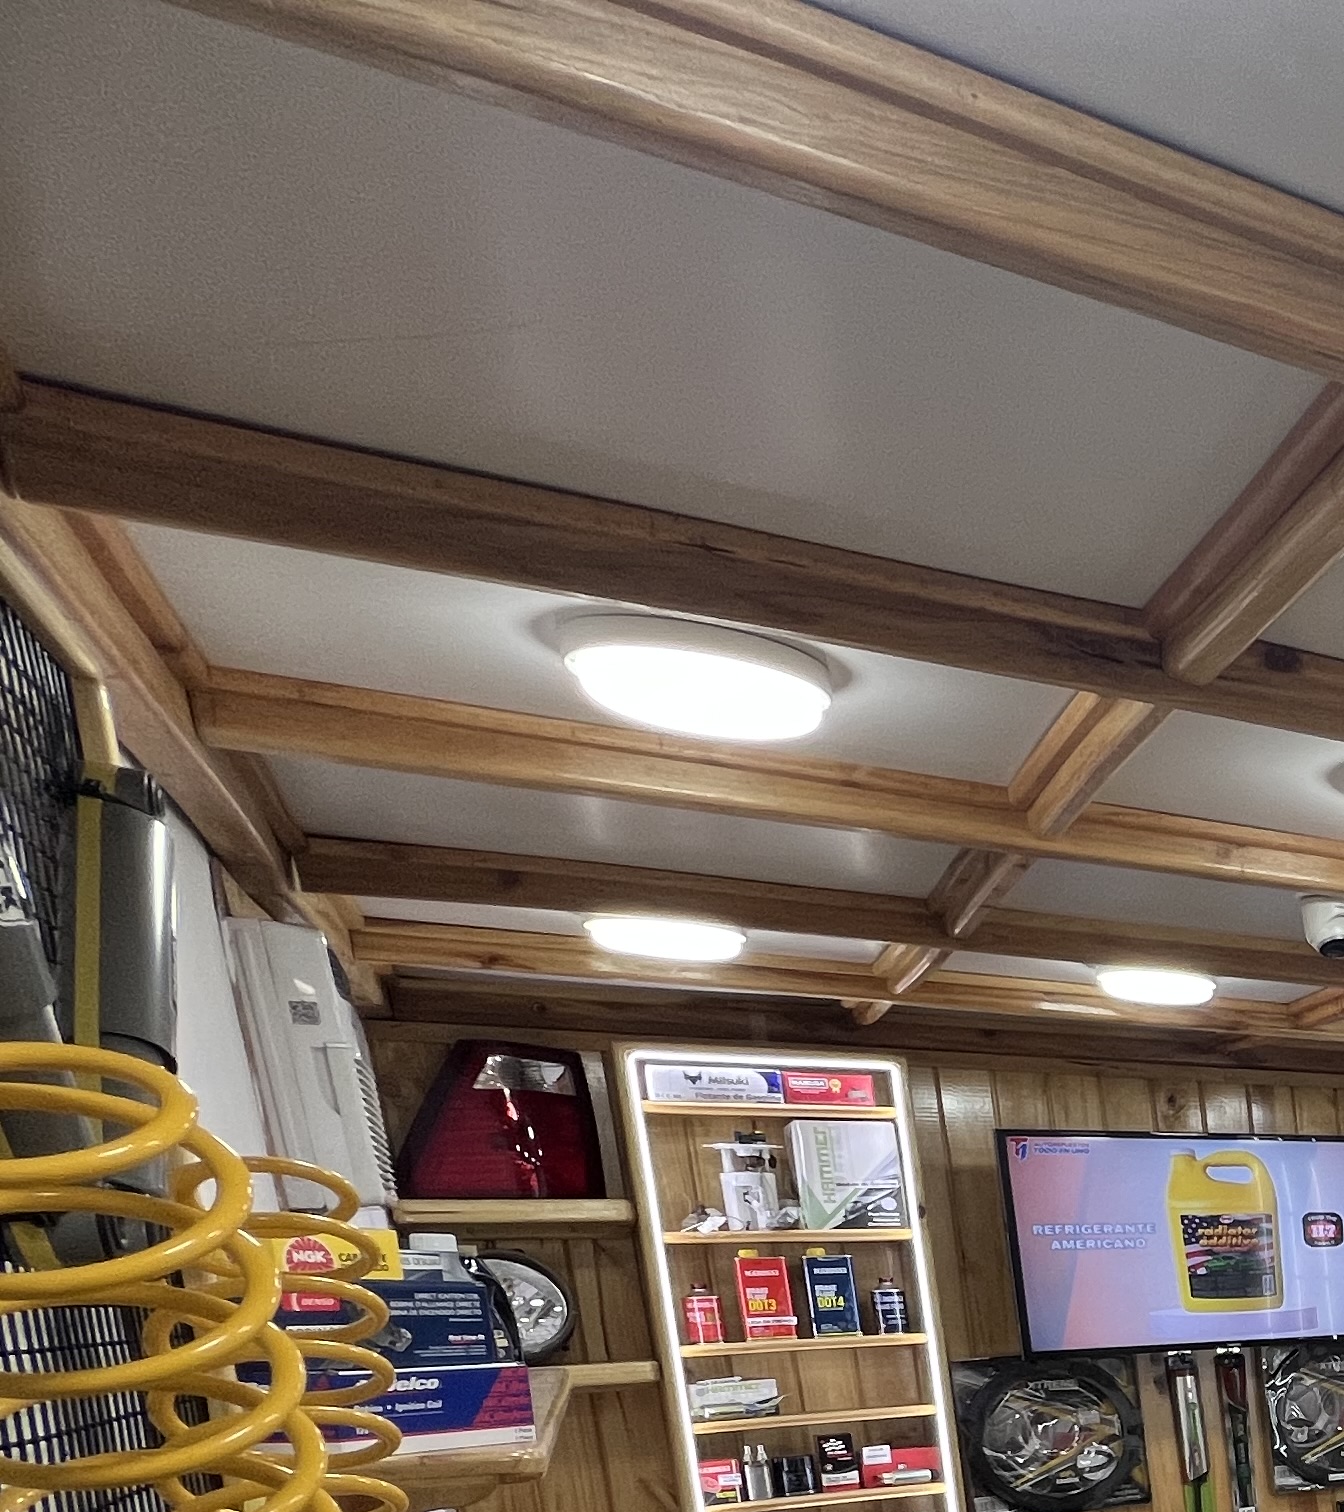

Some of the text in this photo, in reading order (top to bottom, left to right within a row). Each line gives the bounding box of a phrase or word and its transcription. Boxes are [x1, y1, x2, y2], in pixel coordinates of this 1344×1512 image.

[1032, 1223, 1156, 1235] REFRIGERANTE
[1051, 1239, 1146, 1250] AMERICANO
[293, 1250, 328, 1263] NGK
[749, 1299, 777, 1311] DOT3
[818, 1296, 845, 1308] DOT4
